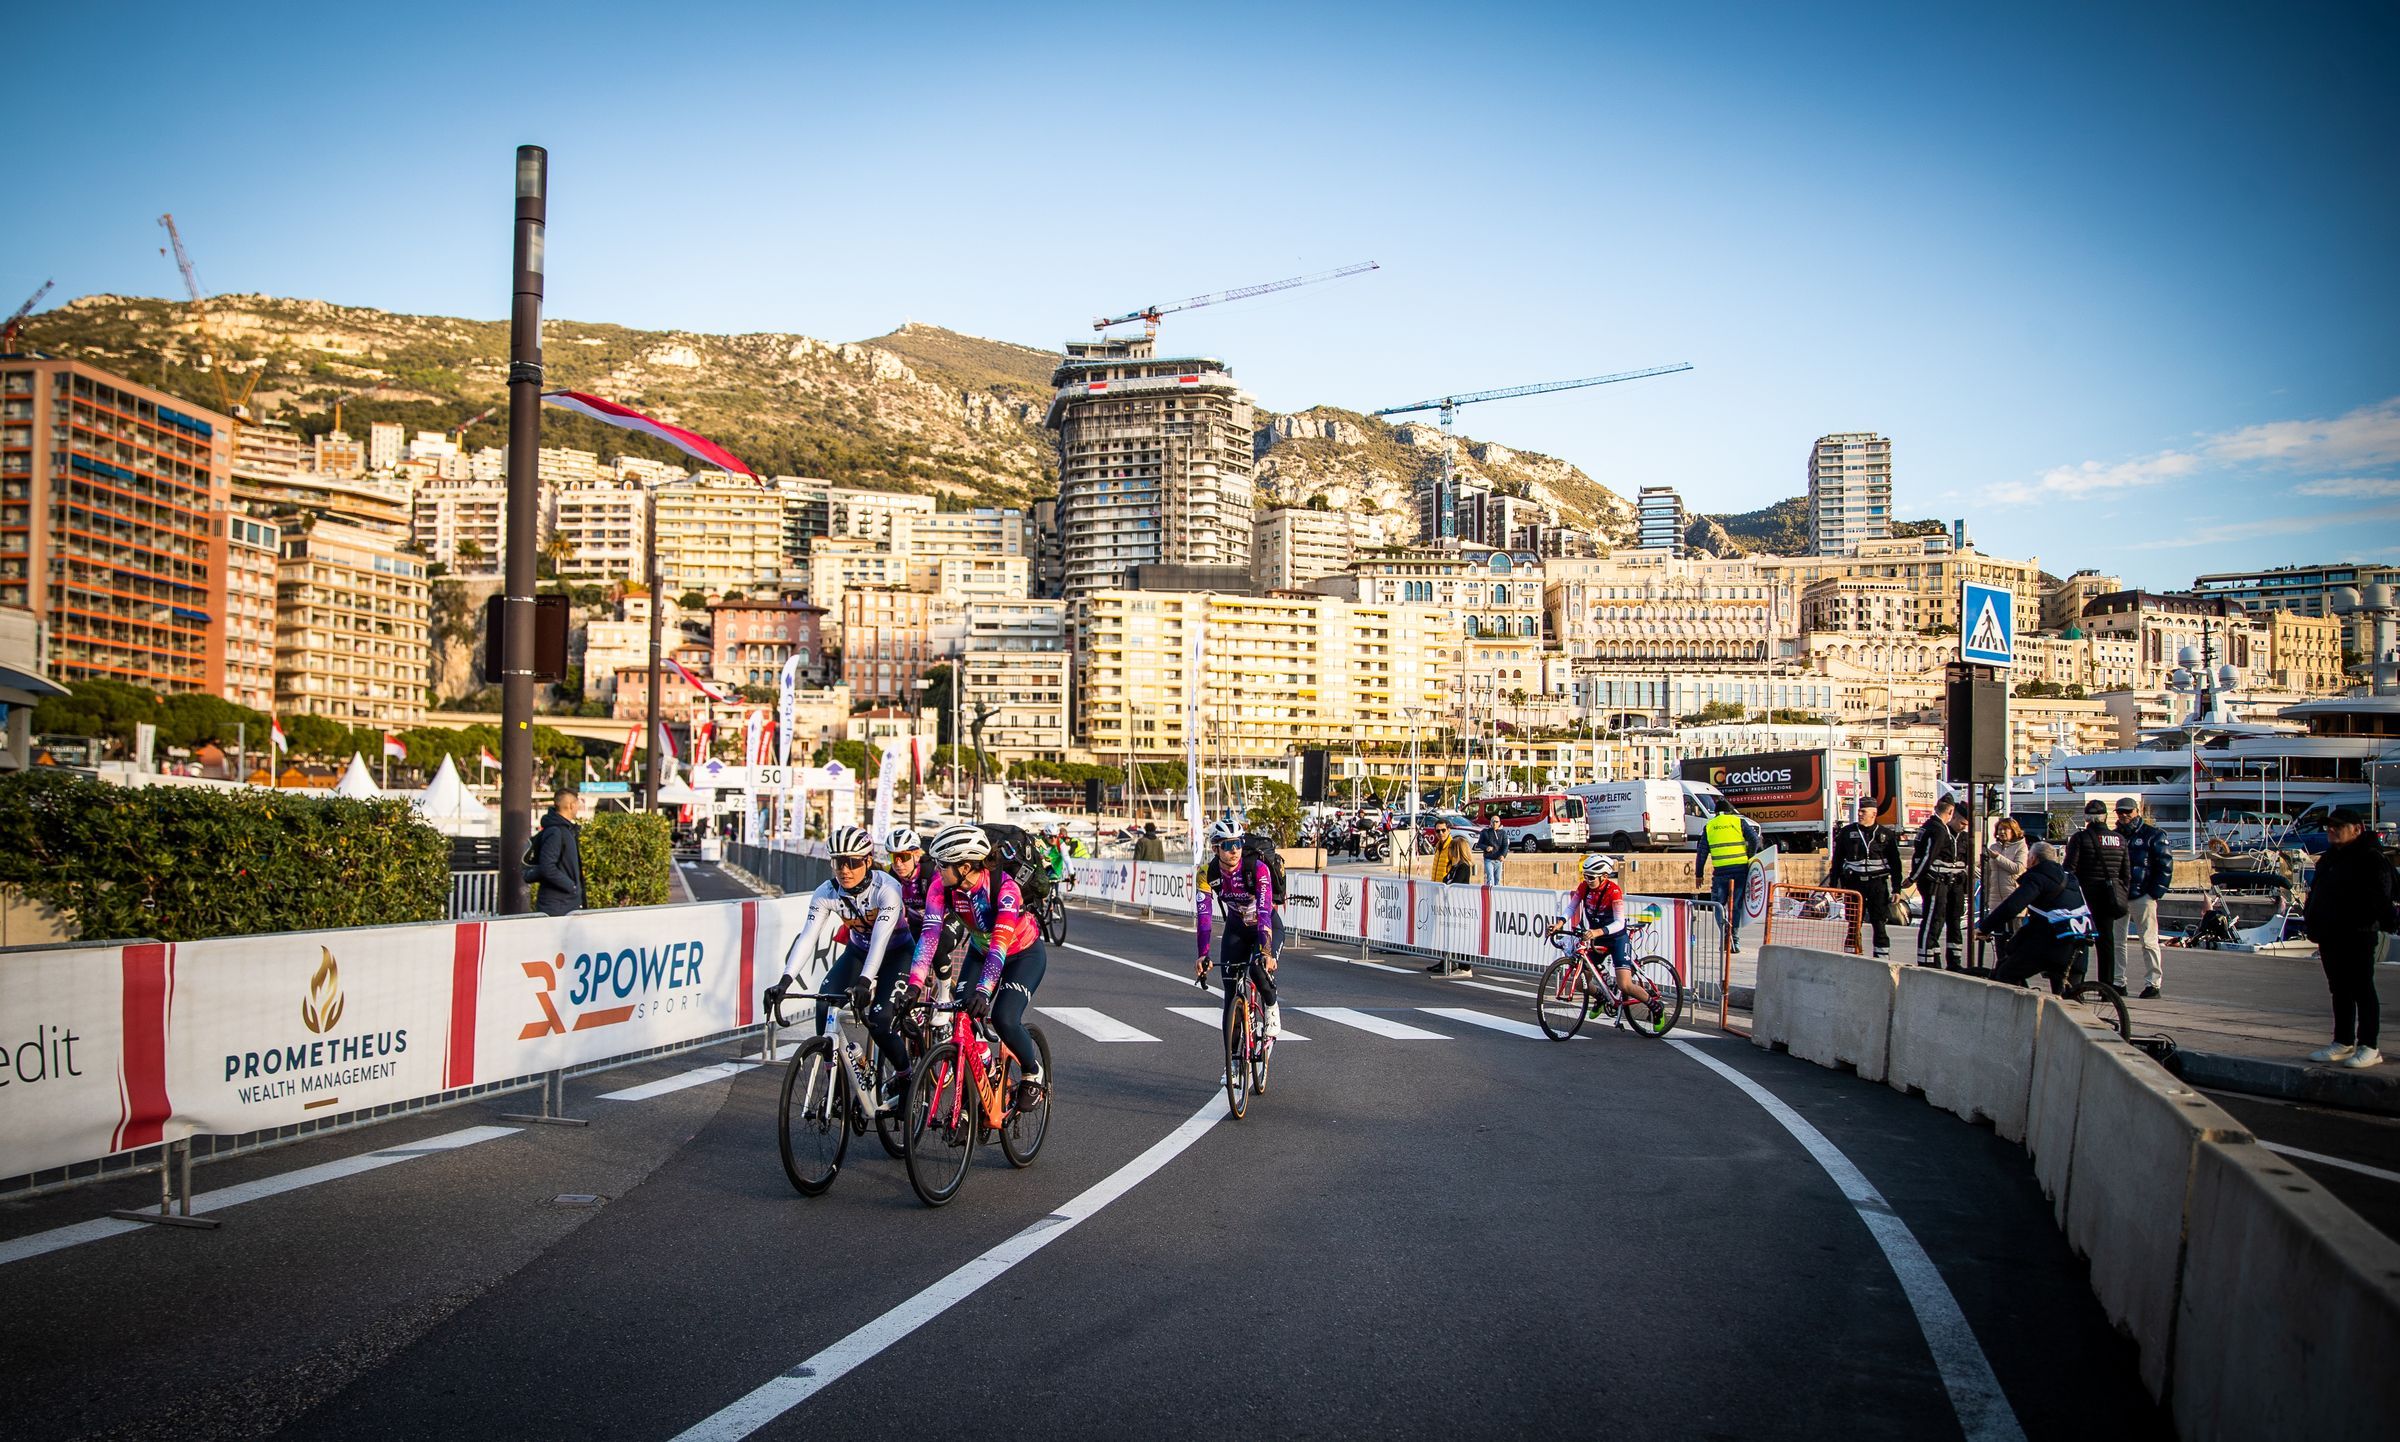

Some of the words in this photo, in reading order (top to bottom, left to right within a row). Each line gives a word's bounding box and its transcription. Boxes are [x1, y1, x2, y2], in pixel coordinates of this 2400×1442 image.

[760, 769, 782, 784] 50
[1713, 766, 1791, 786] Creations
[1148, 873, 1184, 898] TUDOR
[1375, 879, 1399, 900] Santo
[1374, 897, 1402, 920] Gelato
[570, 940, 704, 1006] 3POWER
[638, 993, 702, 1019] SPORT
[225, 1029, 408, 1082] PROMETHEUS
[238, 1079, 296, 1105] WEALTH
[301, 1061, 398, 1094] MANAGEMENT
